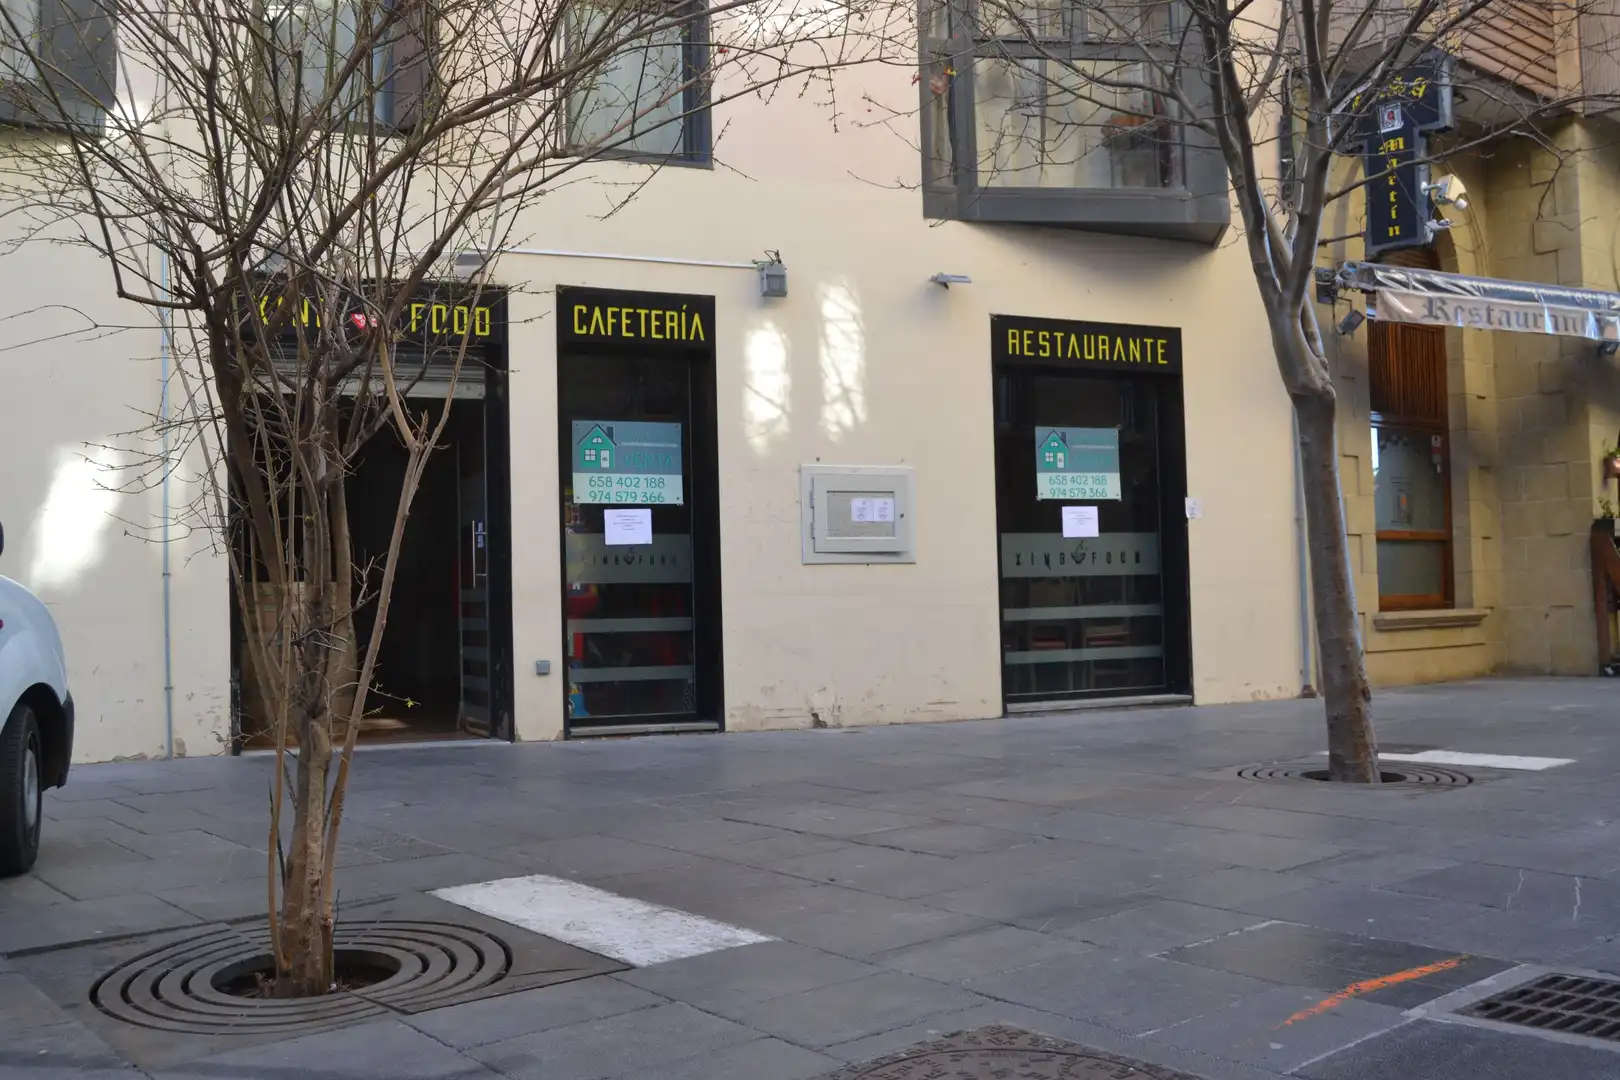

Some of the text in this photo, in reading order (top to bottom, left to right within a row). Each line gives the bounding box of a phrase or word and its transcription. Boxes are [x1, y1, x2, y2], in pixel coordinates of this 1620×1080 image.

[411, 303, 490, 336] FOOD
[573, 304, 706, 342] CAFETERÍA
[1008, 329, 1169, 365] RESTAURANTE
[588, 475, 666, 489] 658 402 188
[1048, 475, 1108, 485] 658 402 188
[588, 490, 665, 503] 974 579 366
[1049, 487, 1108, 498] 974 579 366
